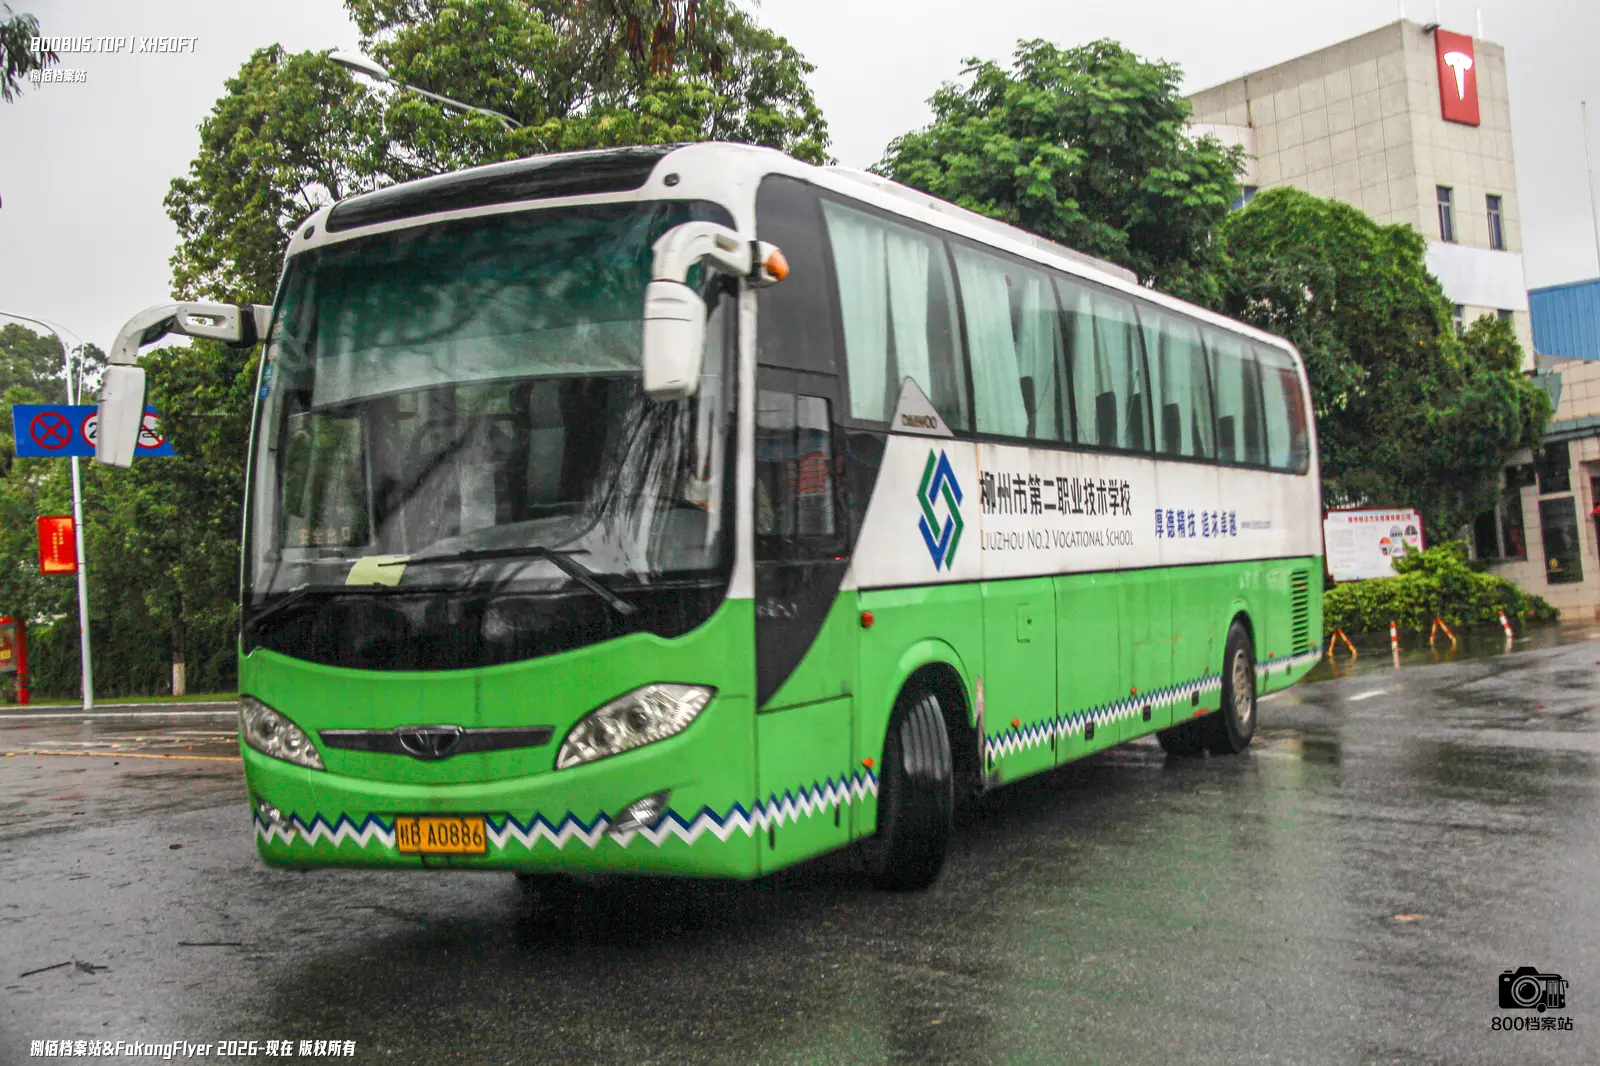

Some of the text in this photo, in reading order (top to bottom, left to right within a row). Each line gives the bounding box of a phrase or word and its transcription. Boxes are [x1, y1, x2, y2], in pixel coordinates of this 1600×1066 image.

[979, 470, 1132, 516] 柳州市第二职业技术学校
[980, 529, 1025, 550] LIUZHOU
[1052, 529, 1104, 548] VOCATIONAL
[1106, 528, 1134, 546] SCHOOL
[428, 822, 482, 847] A0886
